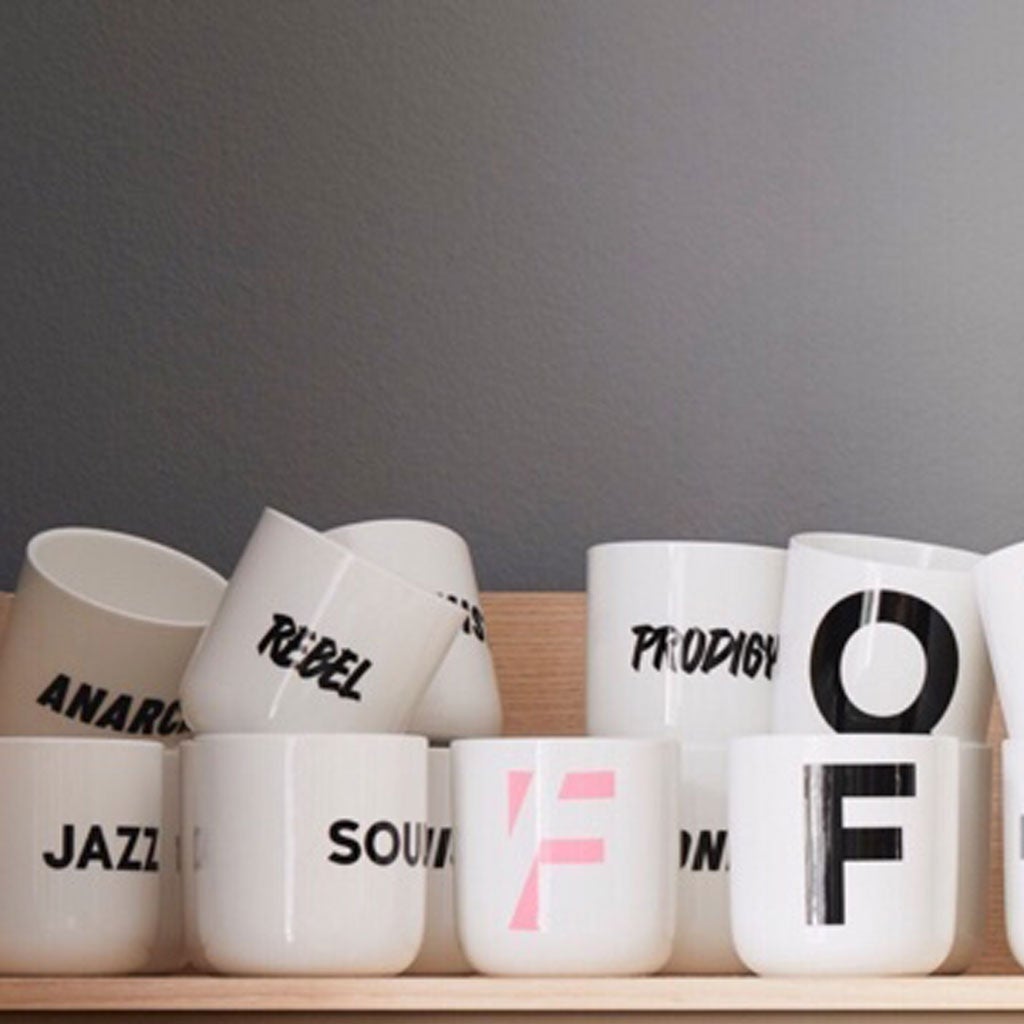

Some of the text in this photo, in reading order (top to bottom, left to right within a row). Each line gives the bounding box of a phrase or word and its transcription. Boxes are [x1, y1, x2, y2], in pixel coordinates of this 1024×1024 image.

[257, 613, 372, 702] REBEL
[631, 624, 780, 680] PRODIGY
[810, 589, 959, 735] O
[36, 673, 192, 736] ANARC
[43, 824, 159, 872] JAZZ
[328, 819, 425, 866] SOU
[804, 763, 916, 925] F
